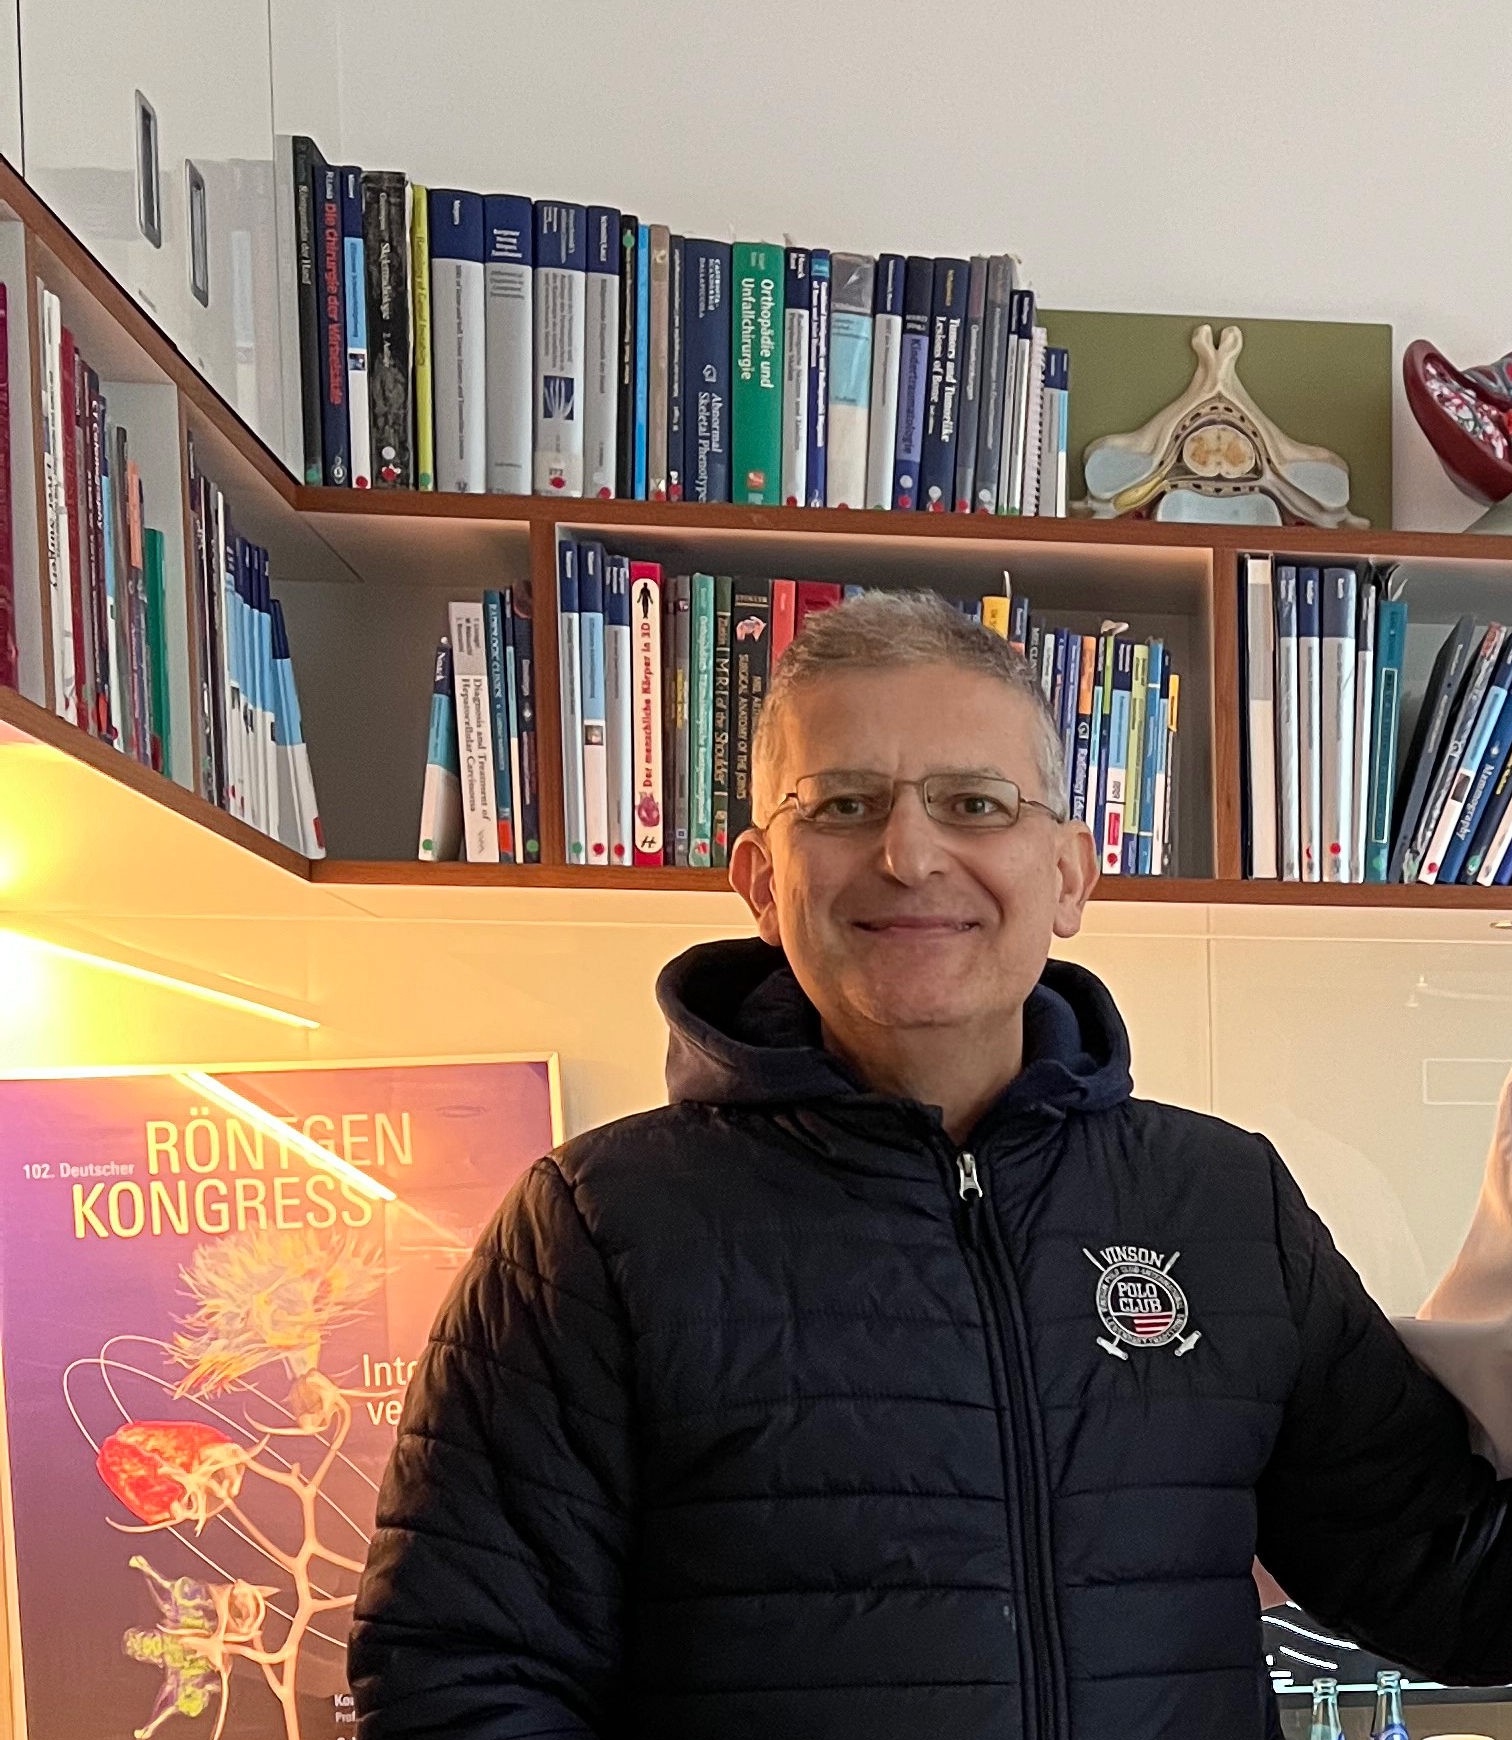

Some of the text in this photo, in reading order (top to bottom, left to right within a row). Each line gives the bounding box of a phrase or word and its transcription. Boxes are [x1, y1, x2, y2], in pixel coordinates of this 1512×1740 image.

[326, 295, 340, 321] der
[737, 278, 755, 379] Unfallchirurgie
[757, 278, 774, 387] Orthopädie und
[697, 392, 710, 436] Skeletal
[711, 393, 723, 453] Abnormal
[641, 656, 651, 694] Körper
[460, 678, 477, 812] Hepatocellular Carcinoma
[473, 679, 490, 821] Diagnosis and Treatment of
[714, 732, 729, 783] Shoulder
[643, 768, 653, 787] Der
[1455, 762, 1496, 841] Mammography
[146, 1106, 414, 1176] RÖNTGEN
[23, 1161, 135, 1180] 102. Deutscher
[71, 1174, 374, 1240] KONGRESS
[1100, 1246, 1165, 1268] VINSON
[1117, 1282, 1158, 1298] POLO
[1119, 1298, 1162, 1313] CLUB
